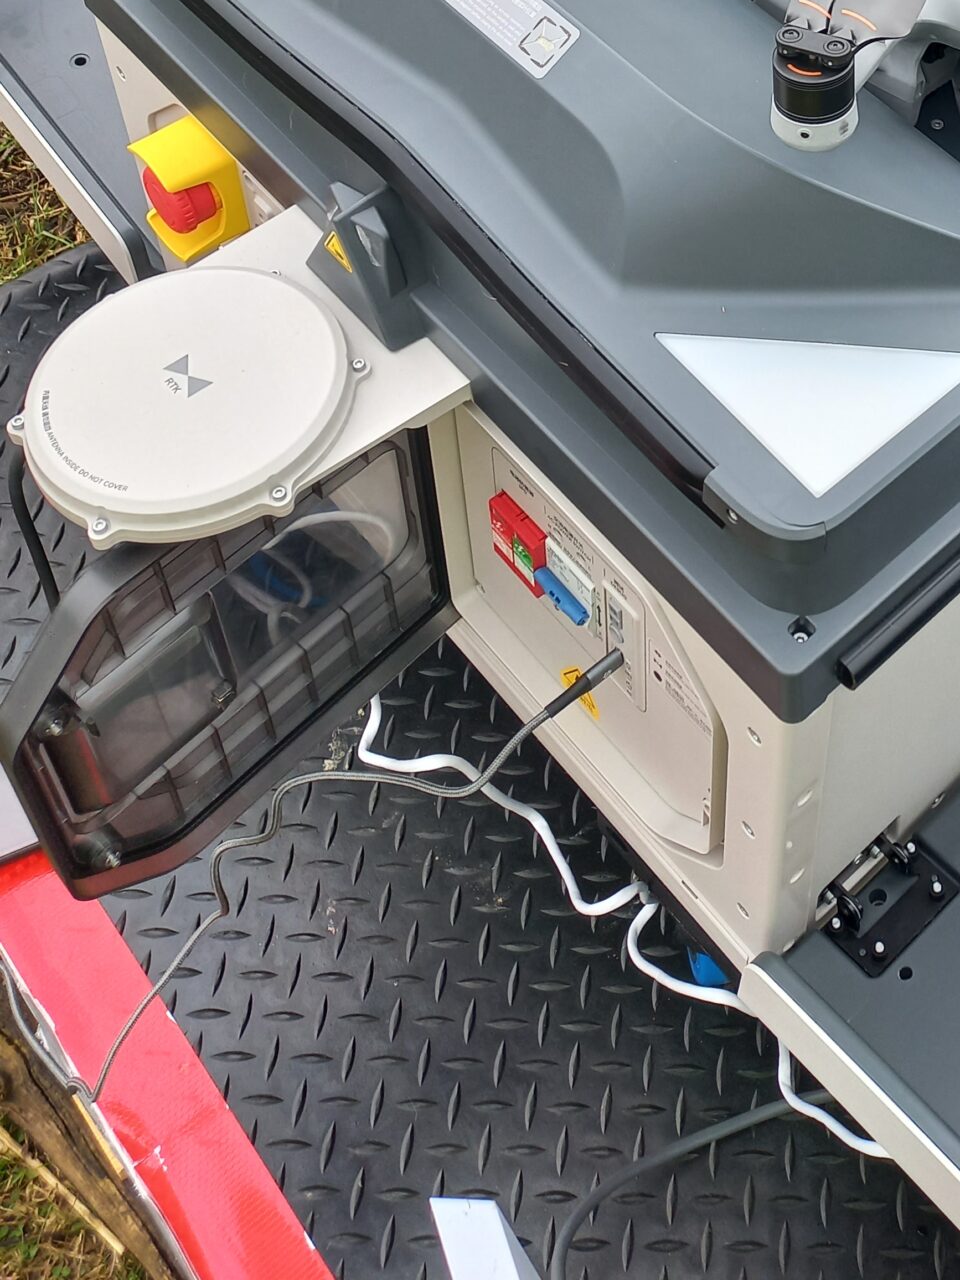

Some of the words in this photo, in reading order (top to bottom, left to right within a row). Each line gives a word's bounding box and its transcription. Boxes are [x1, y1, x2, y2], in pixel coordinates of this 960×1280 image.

[164, 377, 182, 395] RTK
[47, 431, 64, 457] ANTENNA
[62, 455, 80, 472] INSIDE
[78, 468, 89, 477] DO
[88, 474, 103, 484] NOT
[103, 480, 129, 492] COVER
